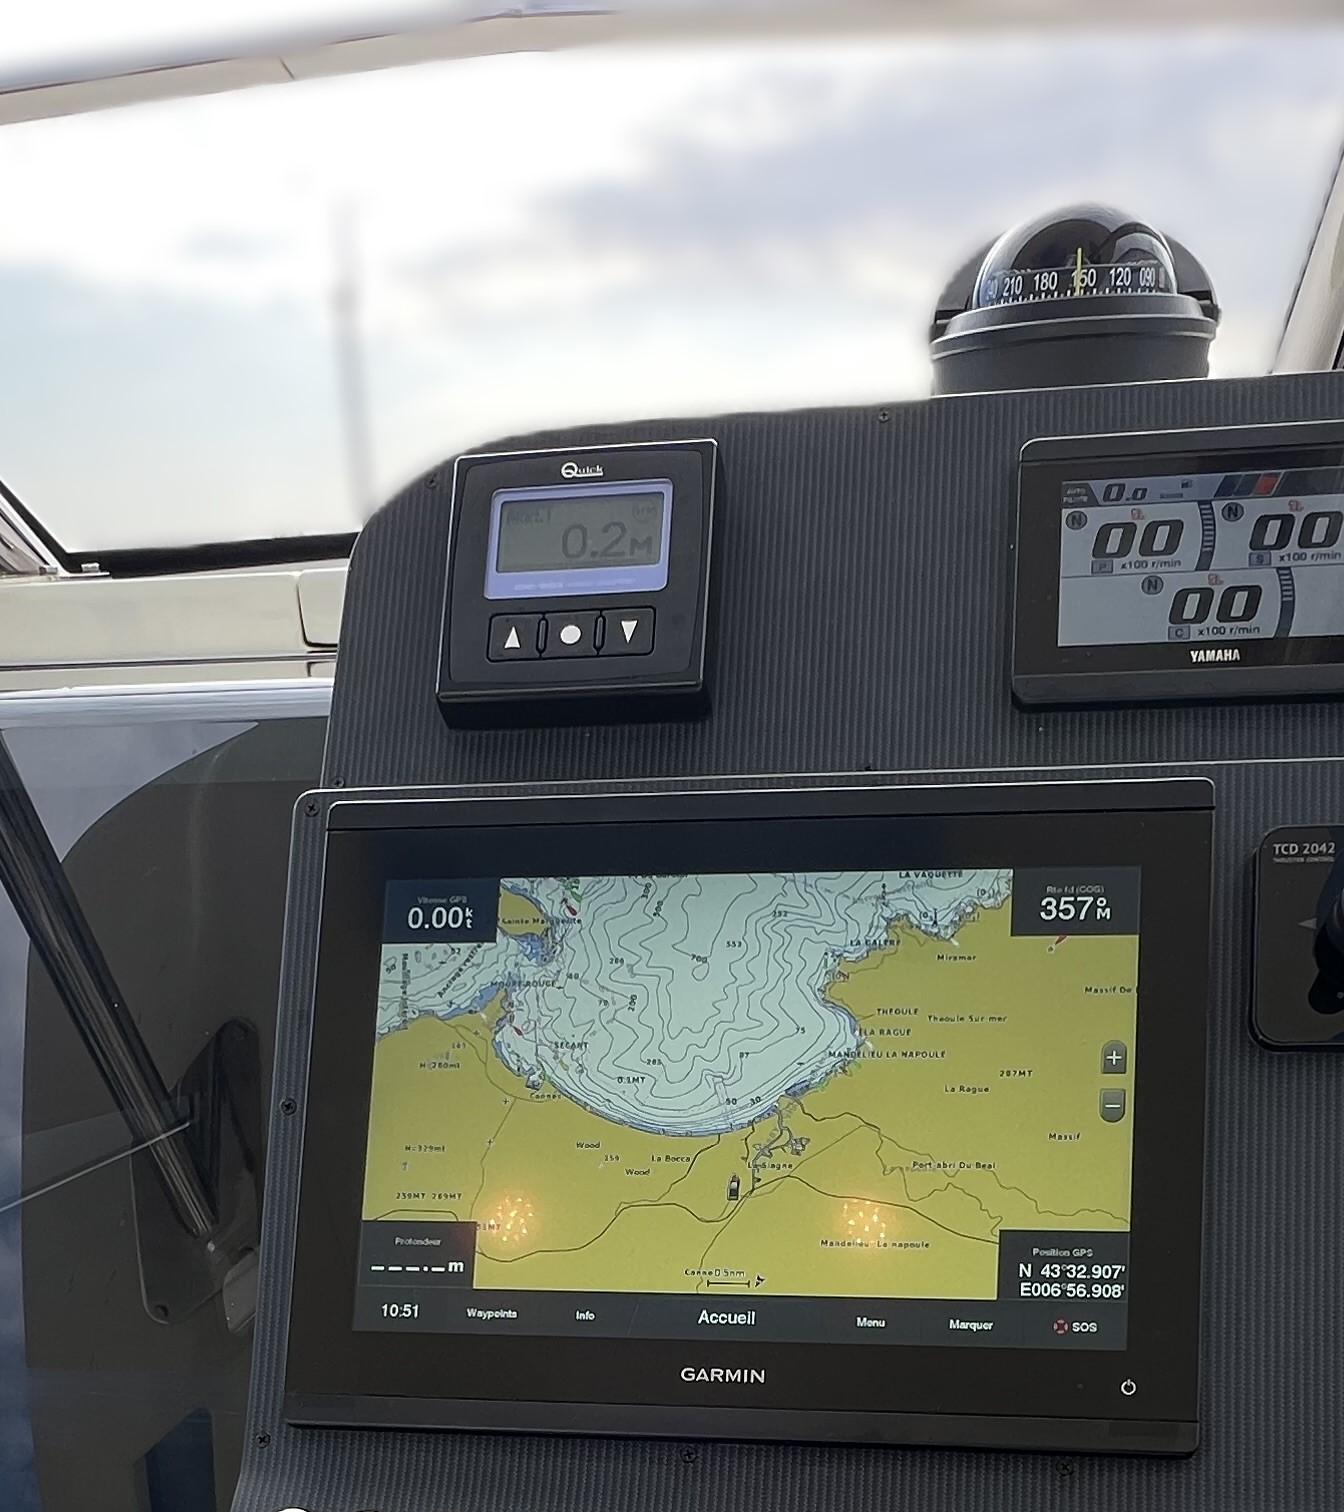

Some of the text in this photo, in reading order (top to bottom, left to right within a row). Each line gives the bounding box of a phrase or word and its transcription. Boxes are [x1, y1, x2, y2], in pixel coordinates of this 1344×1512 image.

[1003, 274, 1024, 297] 210
[1033, 271, 1058, 292] 180
[1109, 266, 1132, 287] 120
[1139, 267, 1156, 287] 090
[561, 462, 604, 478] Quick
[1102, 483, 1148, 503] 0.0
[1249, 510, 1344, 551] 00
[1092, 519, 1184, 559] 00
[1150, 558, 1182, 569] r/min
[1278, 551, 1307, 562] x100
[1309, 550, 1342, 561] r/min
[1168, 585, 1262, 625] 00
[1197, 624, 1226, 636] x100
[1228, 624, 1261, 635] r/min
[1190, 648, 1240, 663] YAMAHA
[1272, 841, 1336, 856] TCD 2042
[1040, 896, 1094, 922] 357
[407, 906, 465, 930] 0.00
[879, 1028, 912, 1036] RAGUE
[901, 1050, 947, 1059] NAPOULE
[959, 1085, 990, 1095] Rague
[1048, 1132, 1081, 1141] Massif
[575, 1141, 601, 1150] Wood
[624, 1168, 651, 1176] Wood
[1072, 1248, 1094, 1258] GPS
[1018, 1263, 1032, 1279] N
[381, 1303, 420, 1319] 10:51
[466, 1307, 1098, 1333] Waypoints Info Accueil Menu Marquer SOS
[680, 1367, 766, 1385] GARMIN
